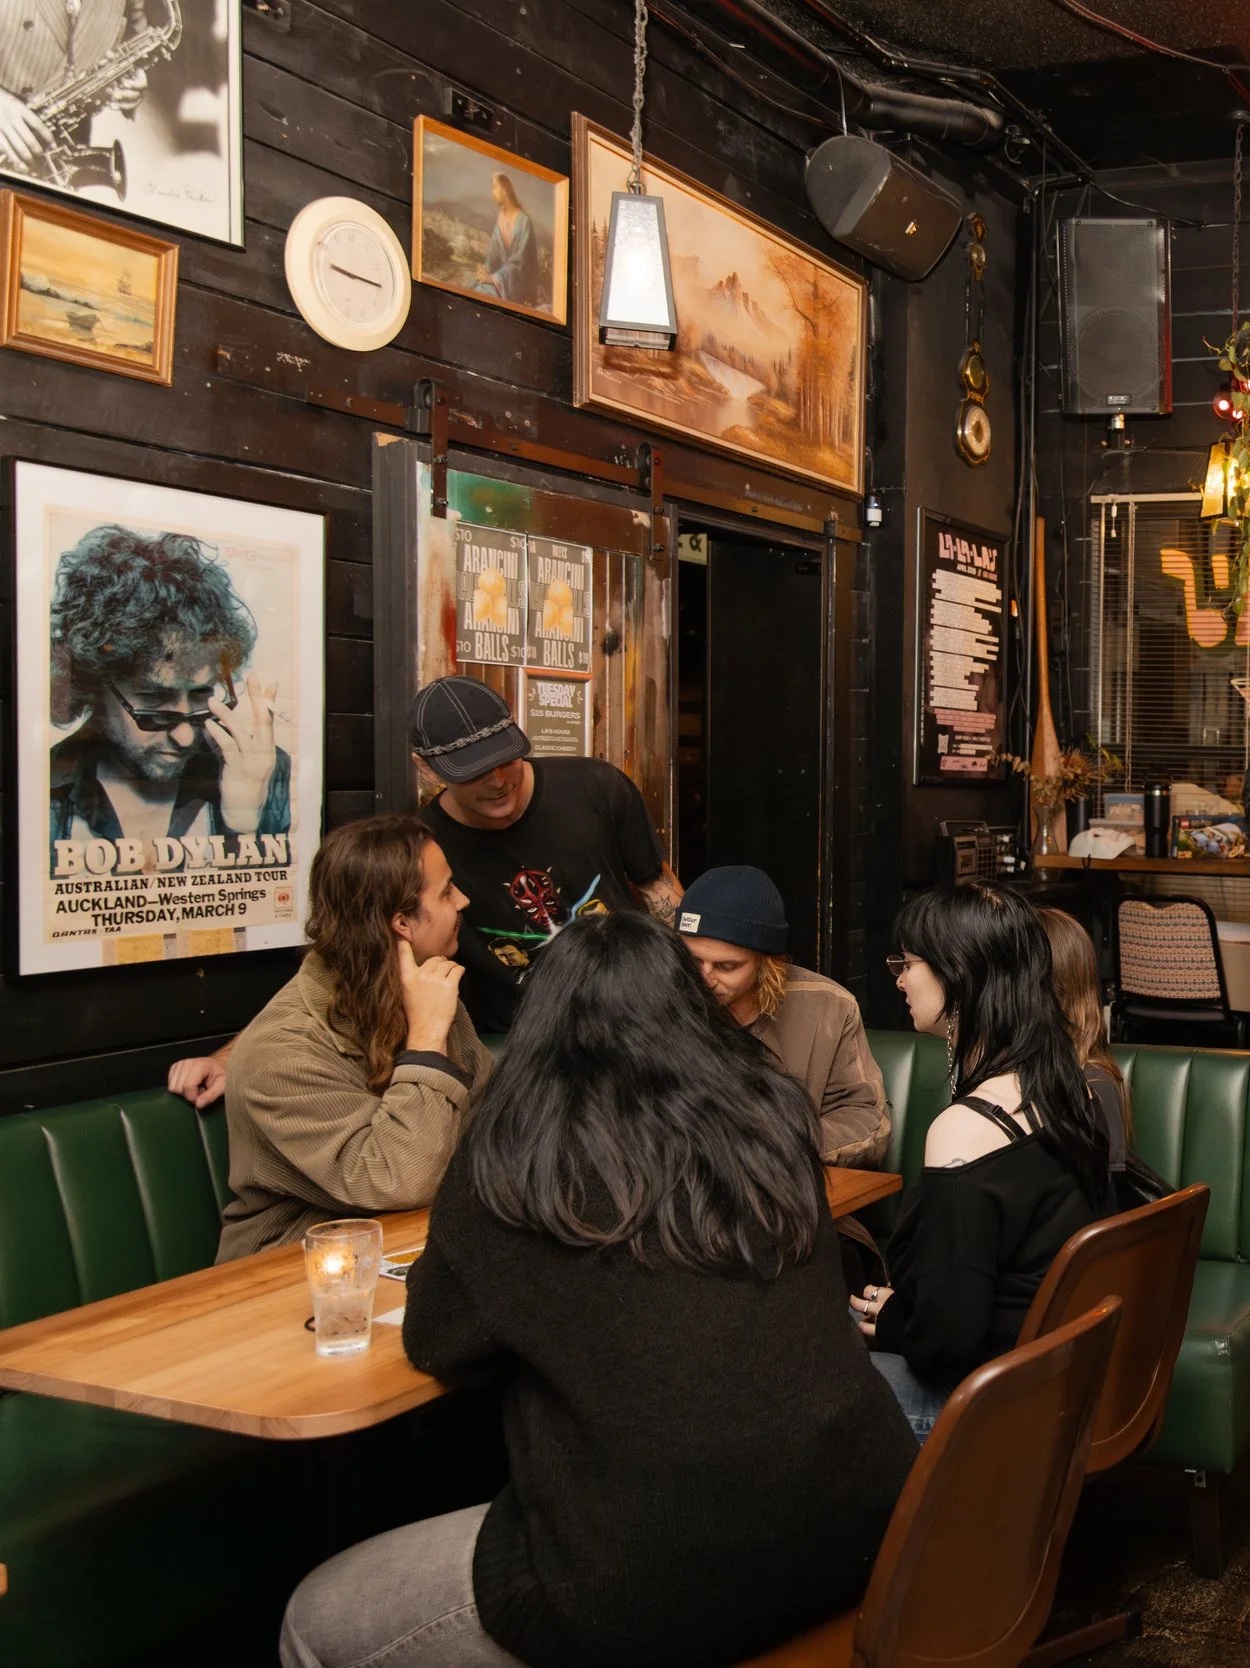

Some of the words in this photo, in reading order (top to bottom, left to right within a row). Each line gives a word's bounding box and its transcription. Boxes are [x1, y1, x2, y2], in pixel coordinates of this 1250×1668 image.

[463, 544, 519, 580] ARANCINI
[537, 557, 584, 590] ARANCINI
[475, 632, 509, 662] BALLS
[543, 640, 575, 668] BALLS
[536, 682, 576, 697] TUESDAY
[538, 693, 573, 708] SPECIAL
[545, 709, 581, 720] BURGERS
[54, 838, 145, 876] BOB
[153, 833, 291, 871] DYLAN
[191, 872, 251, 887] ZEALAND
[255, 870, 288, 882] TOUR
[218, 887, 267, 904] Springs
[91, 907, 180, 928] THURSDAY,
[181, 903, 235, 921] MARCH
[237, 902, 248, 916] 9
[104, 926, 122, 934] TAA
